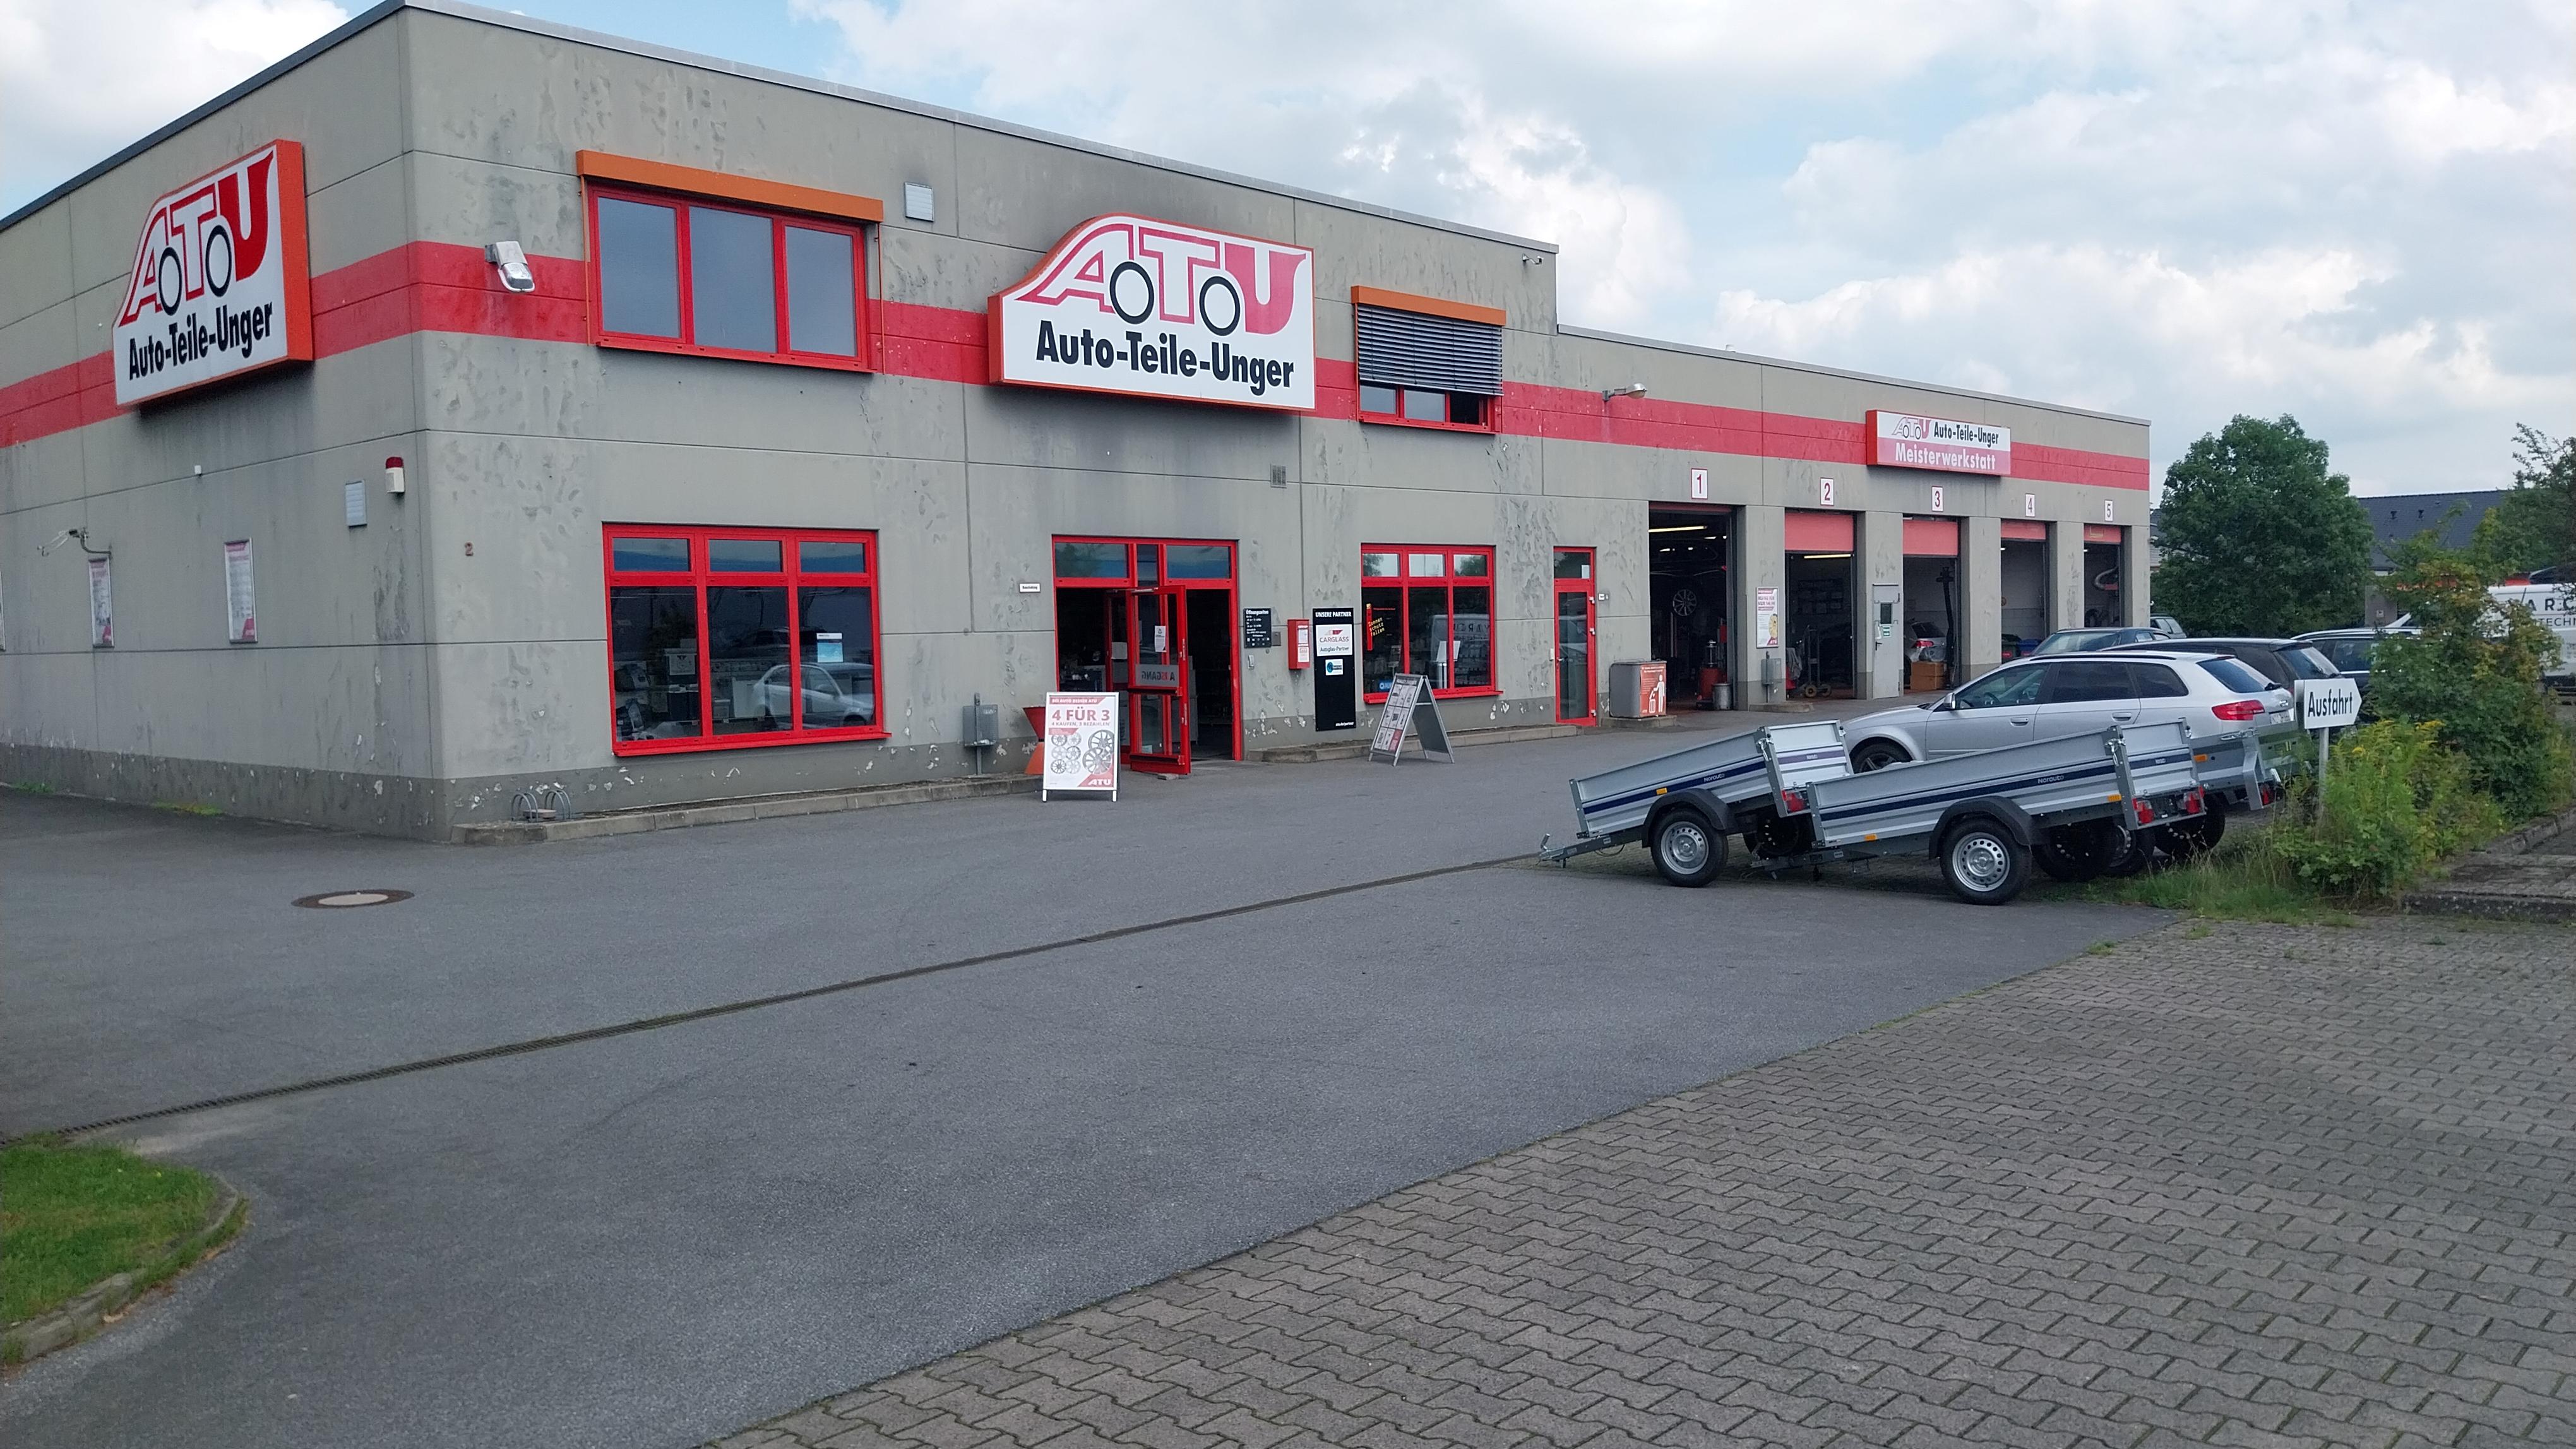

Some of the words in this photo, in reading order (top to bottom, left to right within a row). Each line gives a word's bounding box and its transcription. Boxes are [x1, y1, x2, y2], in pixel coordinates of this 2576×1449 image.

[119, 150, 274, 328] ATU
[1015, 223, 1306, 336] ATU
[129, 301, 272, 380] Auto-Teile-Unger
[1036, 319, 1294, 396] Auto-Teile-Unger
[1933, 421, 1999, 448] Auto-Teile-Unger
[1895, 442, 1996, 470] Meisterwerkstatt
[1696, 474, 1702, 494] 1
[1824, 482, 1830, 501] 2
[1935, 490, 1941, 508] 3
[2027, 497, 2033, 513] 4
[2106, 503, 2111, 518] 5
[464, 542, 474, 556] 2
[2308, 689, 2352, 717] Ausfahrt
[1052, 710, 1061, 720] 4
[1066, 707, 1097, 720] FÜR
[1101, 710, 1110, 720] 3
[1704, 773, 1726, 782] Norauto
[2037, 774, 2065, 784] Norauto
